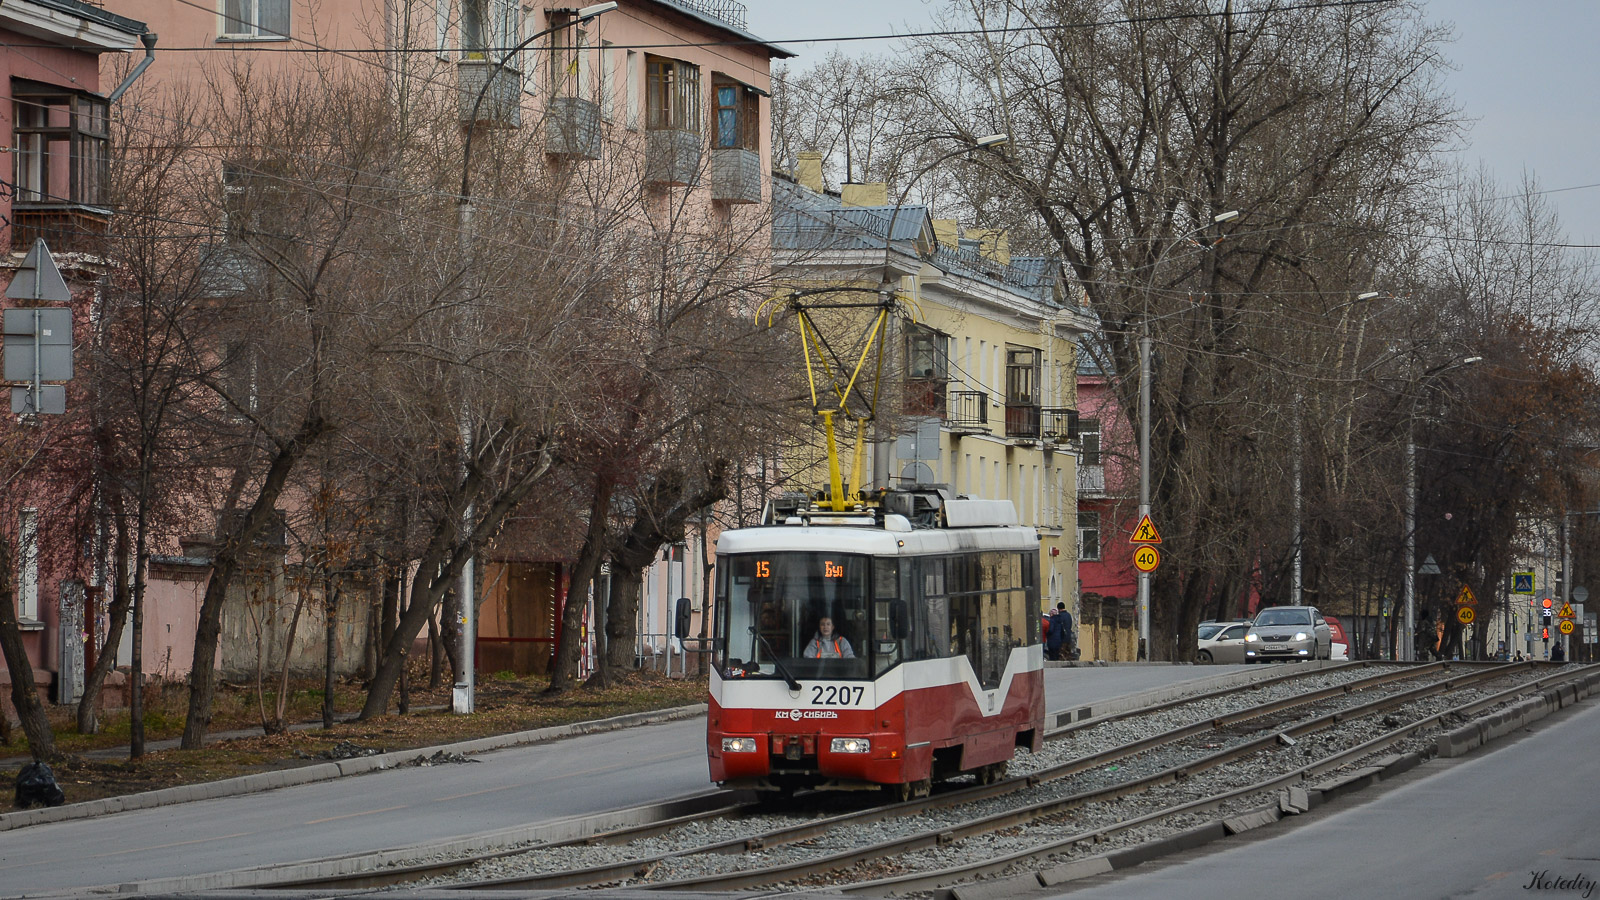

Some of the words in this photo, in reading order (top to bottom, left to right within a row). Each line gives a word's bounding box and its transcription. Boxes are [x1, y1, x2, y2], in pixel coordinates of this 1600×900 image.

[1138, 553, 1154, 565] 40
[756, 561, 770, 577] 15
[1460, 611, 1472, 620] 40
[1562, 623, 1572, 631] 40
[811, 685, 865, 706] 2207
[803, 710, 838, 719] СИБИРЬ
